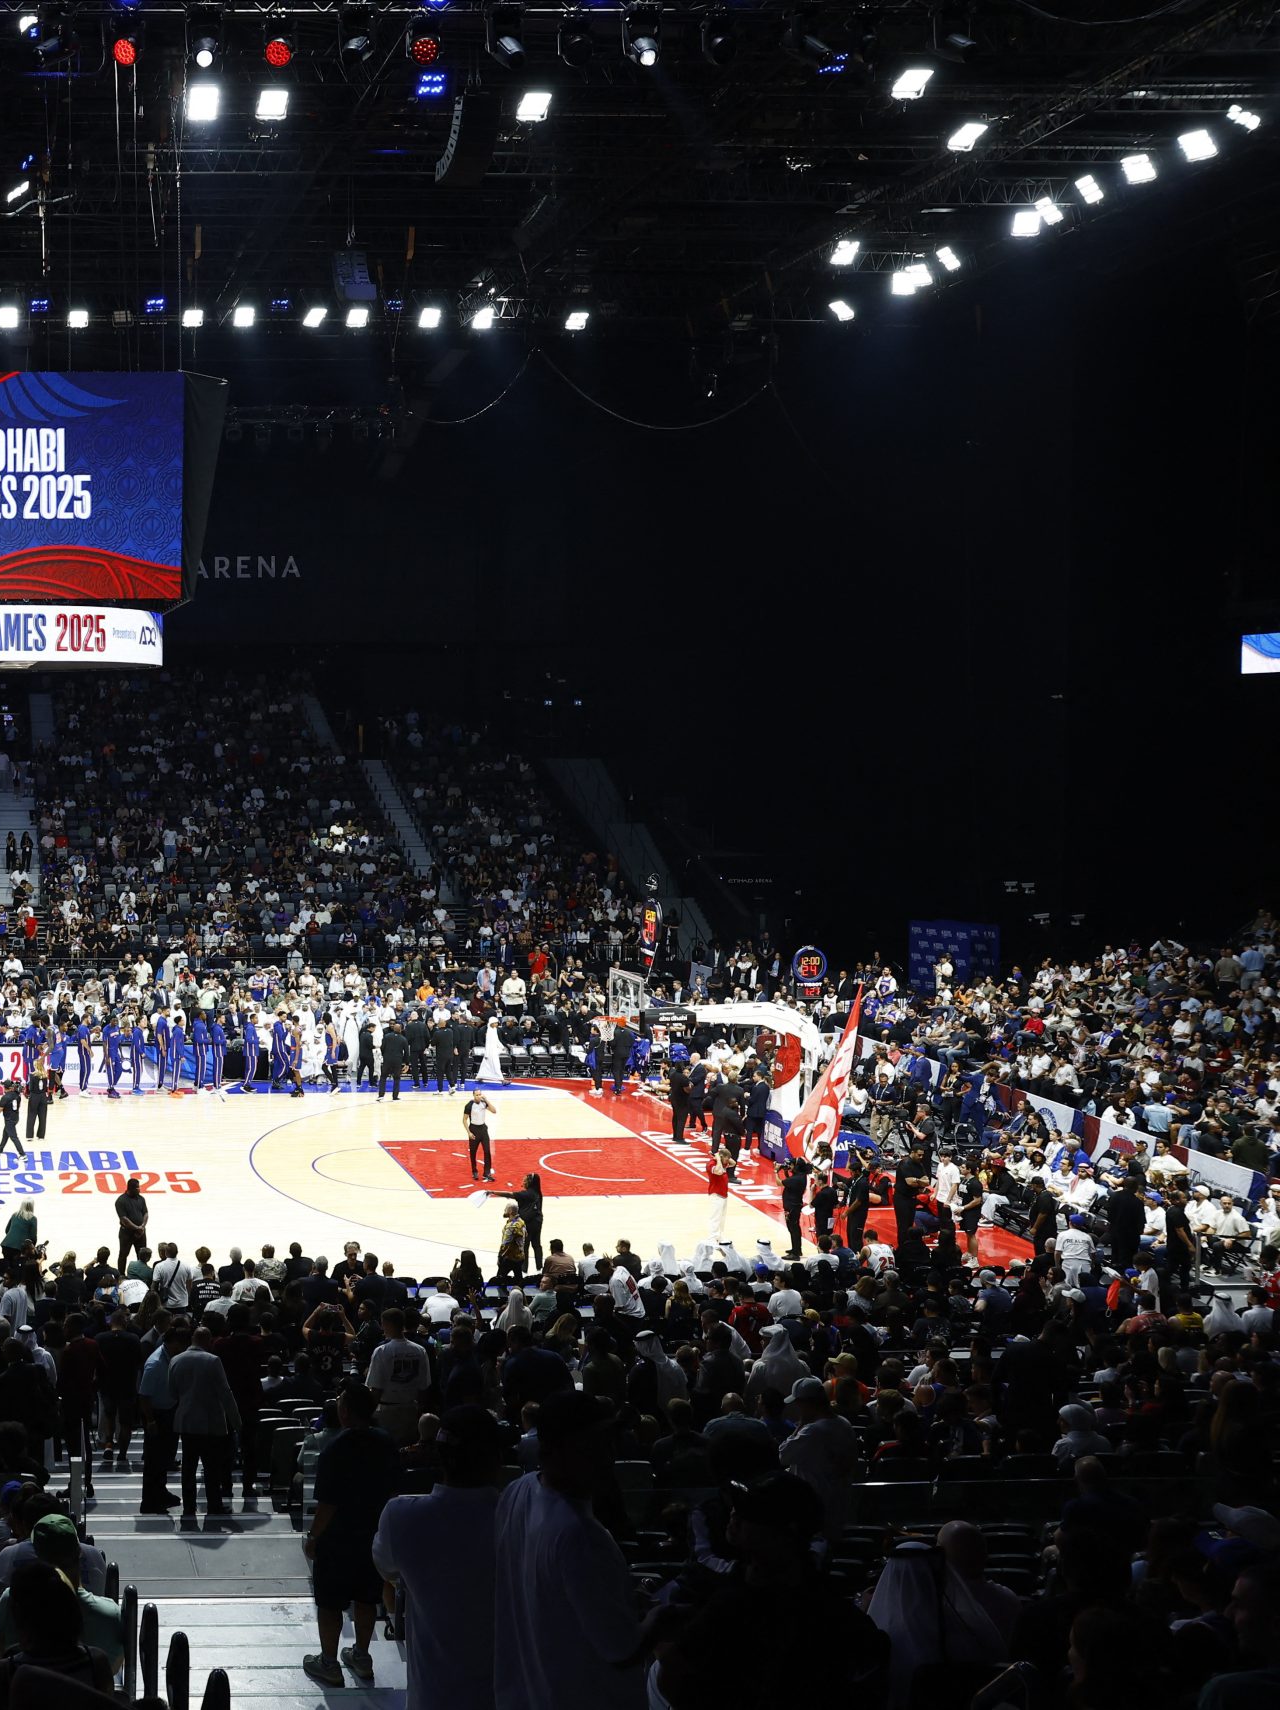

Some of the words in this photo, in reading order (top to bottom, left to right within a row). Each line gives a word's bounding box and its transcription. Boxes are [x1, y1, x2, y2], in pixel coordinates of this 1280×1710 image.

[22, 475, 91, 519] 2025
[196, 556, 301, 579] ARENA
[55, 613, 106, 652] 2025
[801, 957, 820, 965] 12:00
[802, 965, 817, 976] 24
[58, 1171, 202, 1194] 2025
[879, 1256, 894, 1270] 25
